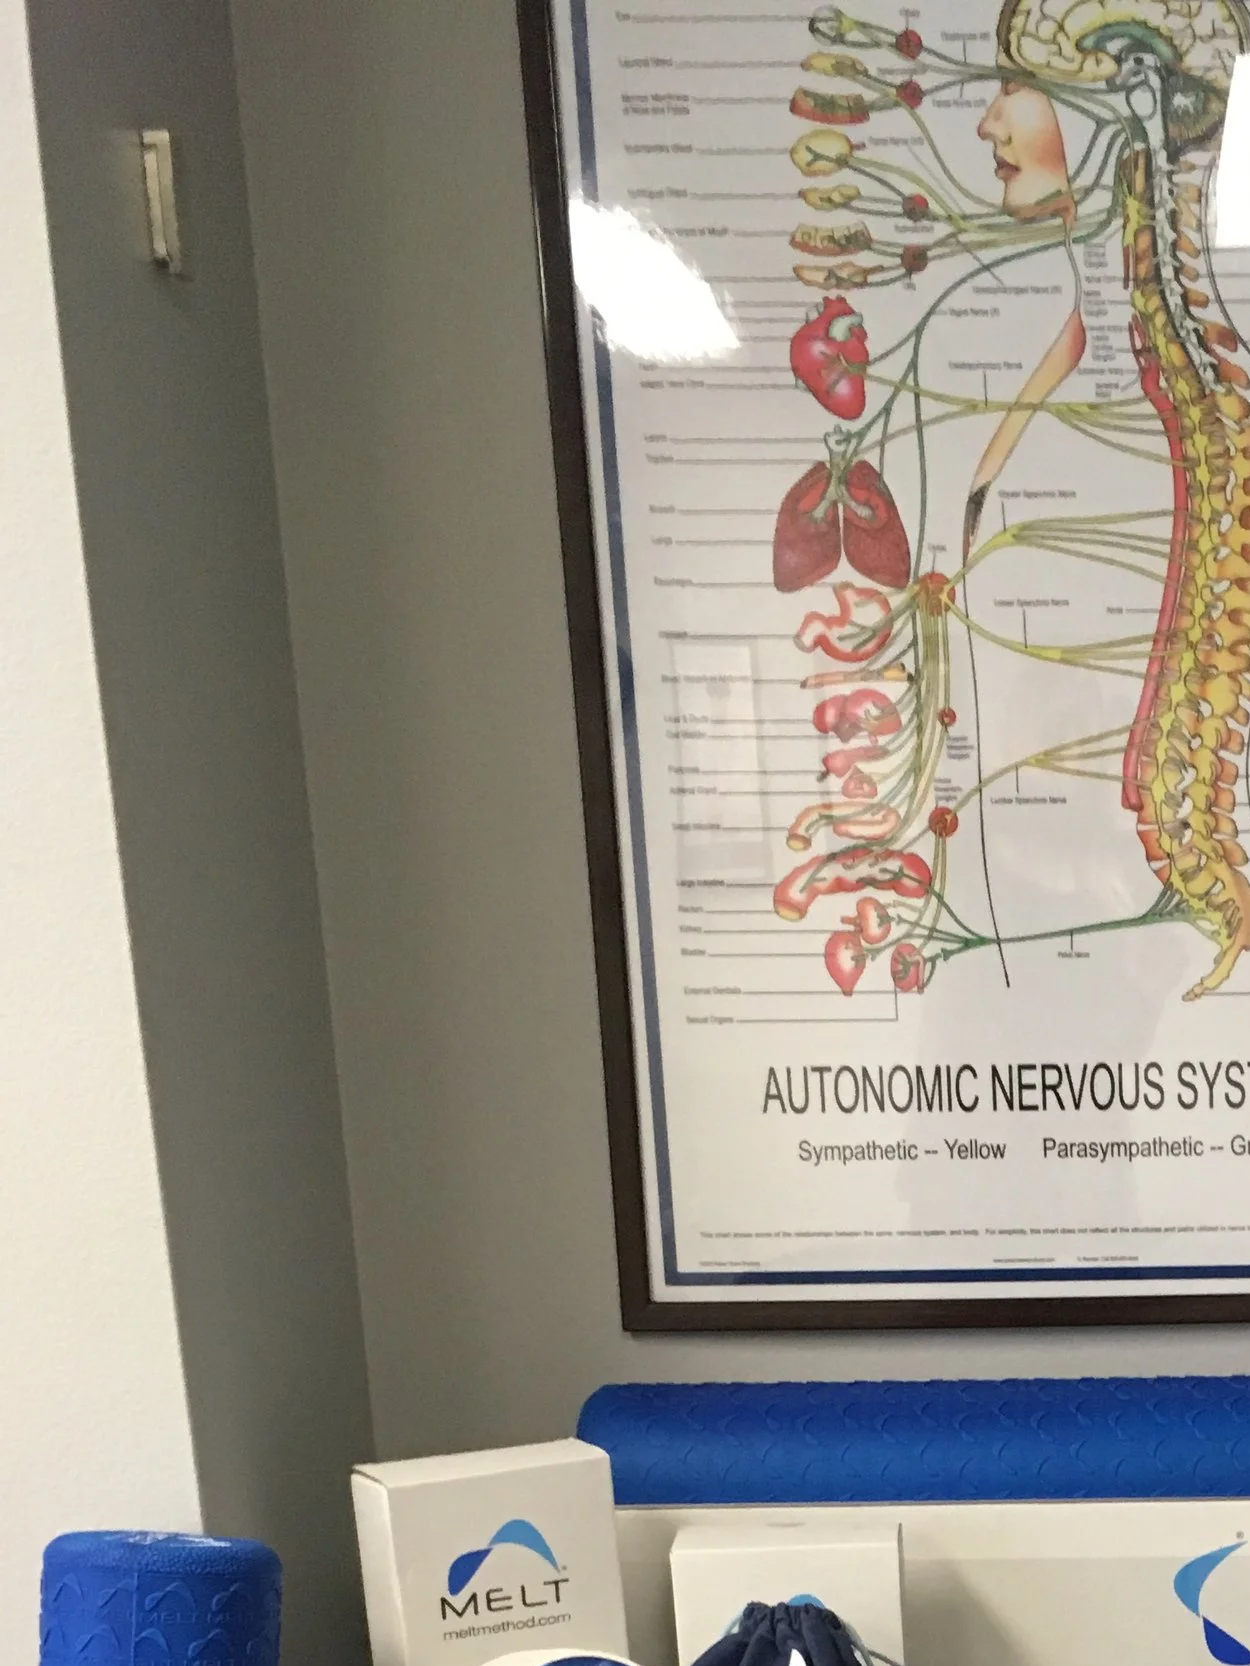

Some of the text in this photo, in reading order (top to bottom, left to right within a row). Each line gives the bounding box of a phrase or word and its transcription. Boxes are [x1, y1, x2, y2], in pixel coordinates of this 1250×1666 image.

[762, 1065, 980, 1115] AUTONOMIC
[990, 1061, 1165, 1112] NERVOUS
[798, 1138, 919, 1166] Sympathetic
[944, 1138, 1007, 1161] Yellow
[1042, 1134, 1204, 1163] Parasympathetic
[440, 1578, 570, 1621] MELT
[443, 1613, 572, 1641] meltmethod.com
